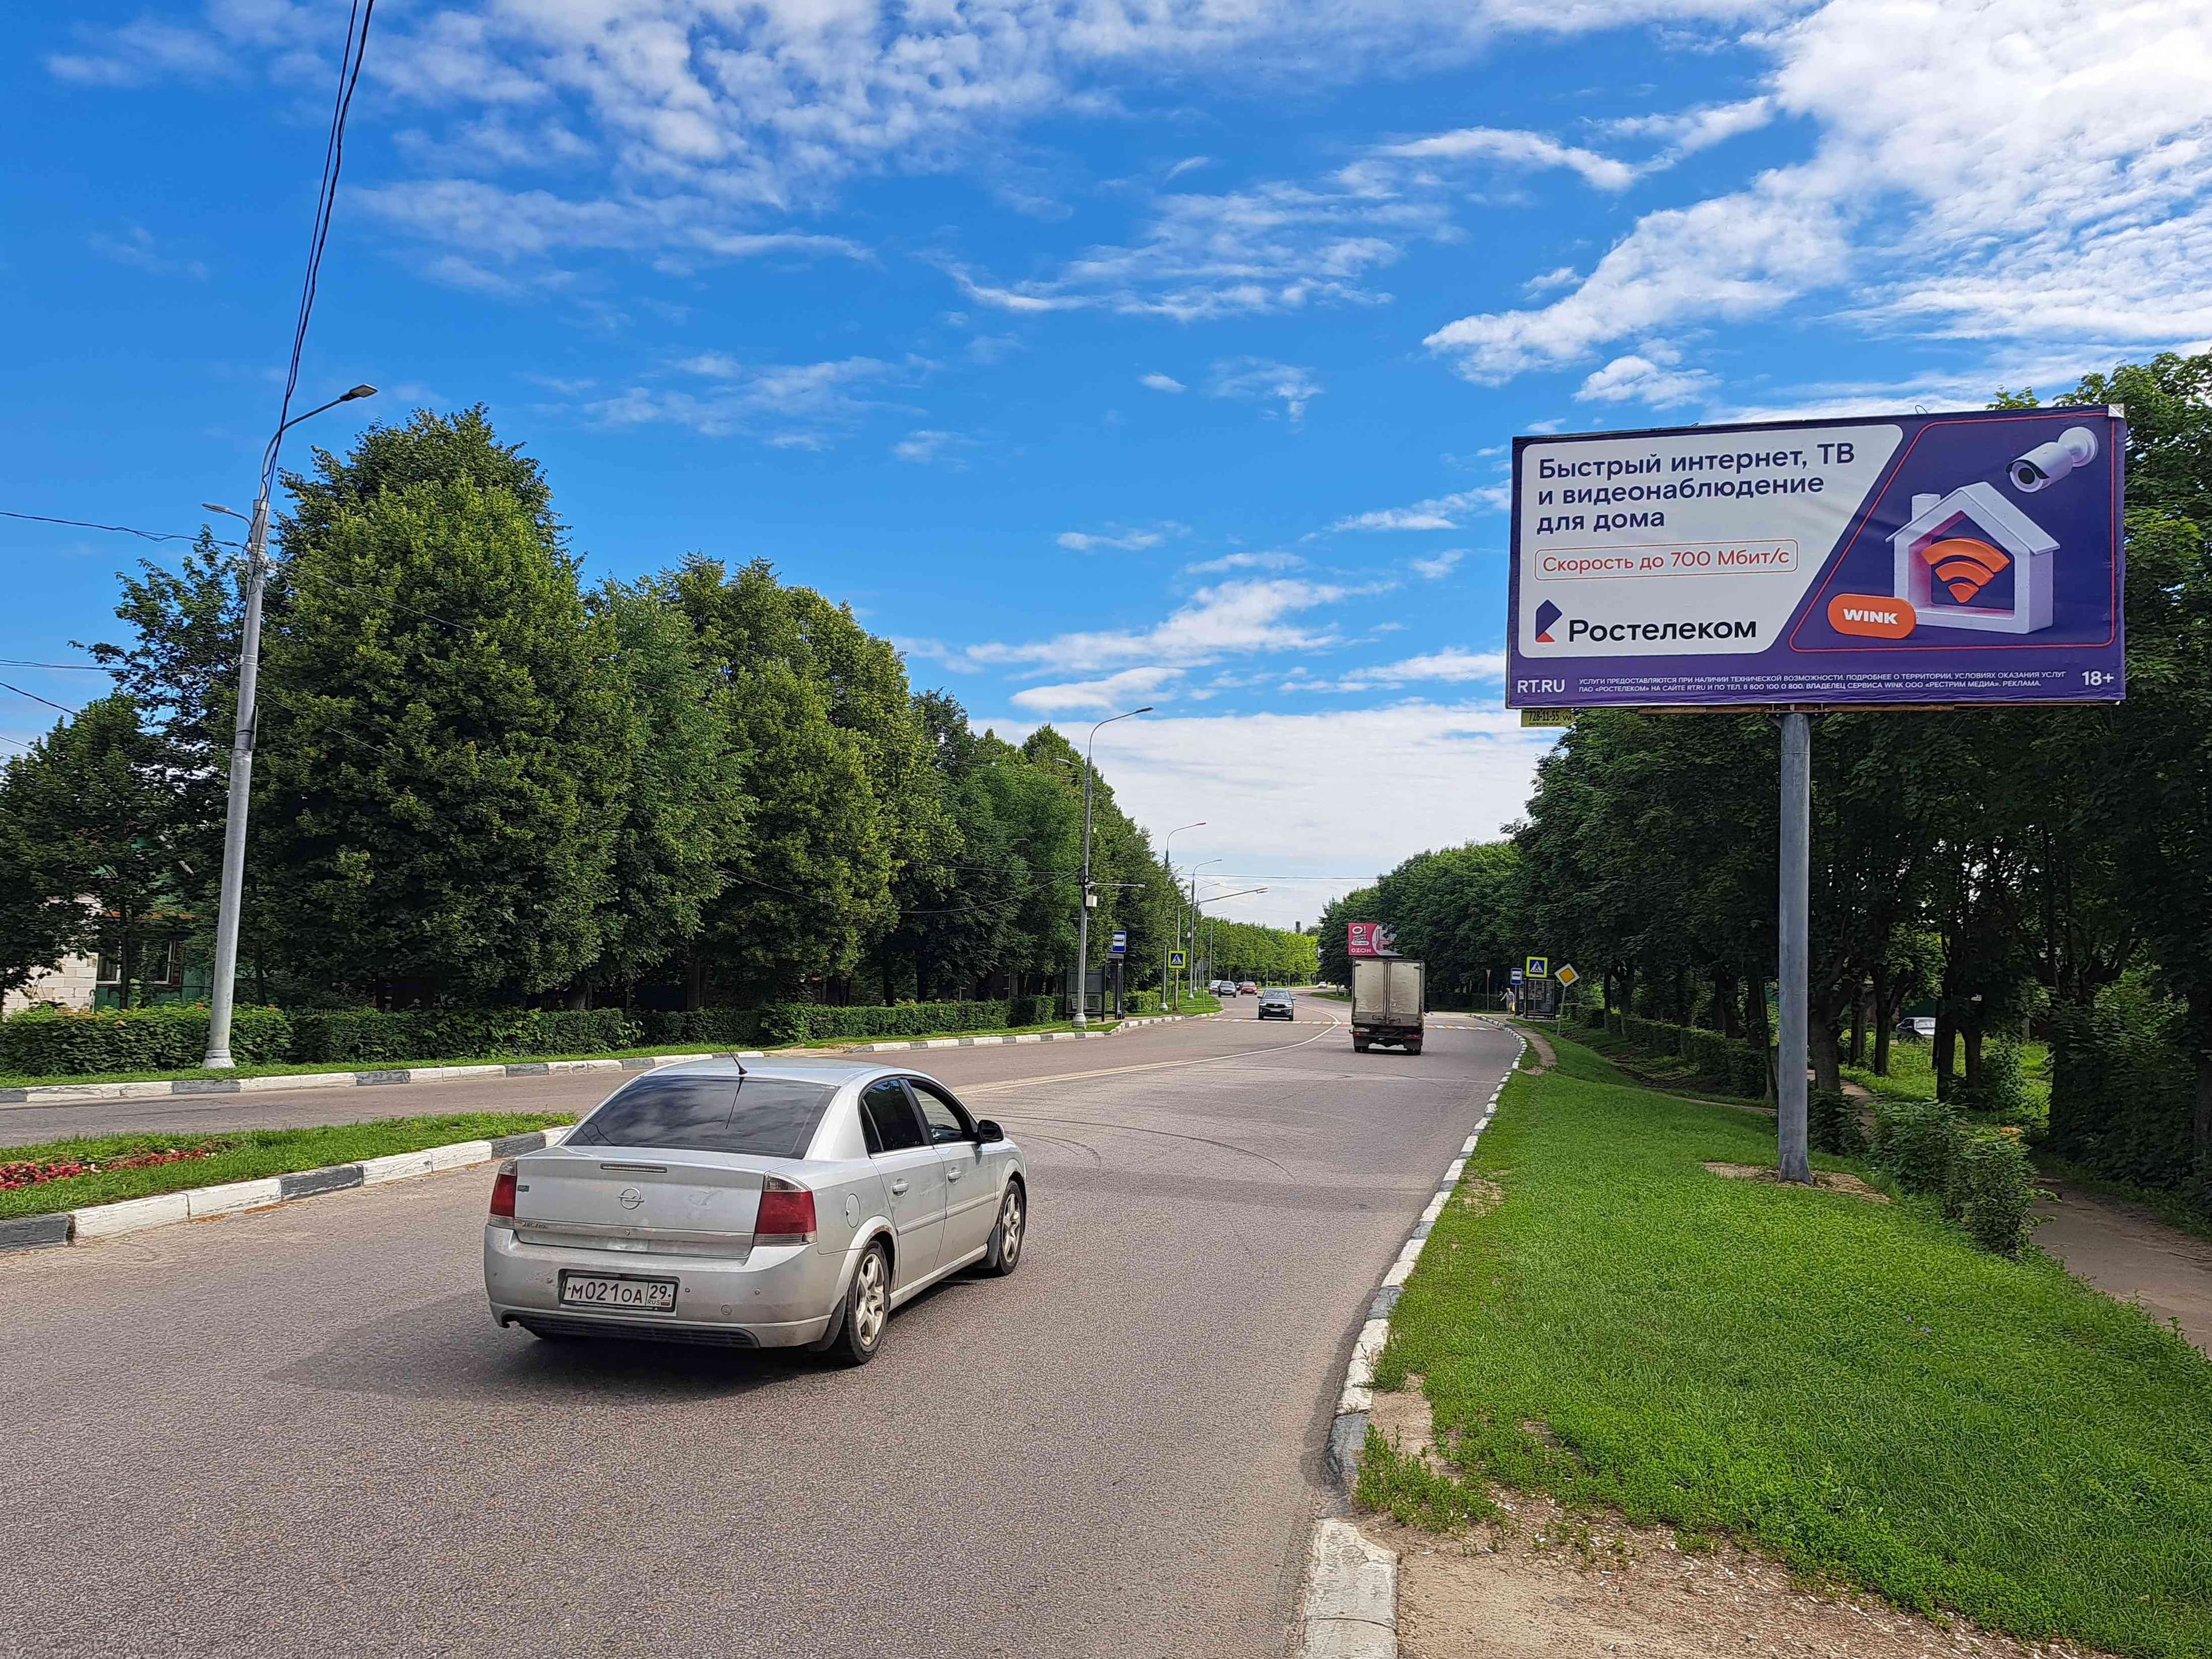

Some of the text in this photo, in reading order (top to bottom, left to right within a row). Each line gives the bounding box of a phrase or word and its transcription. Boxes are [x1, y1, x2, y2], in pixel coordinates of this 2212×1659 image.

[1539, 442, 1855, 480] Быстрый интернет, ТВ
[1539, 477, 1824, 506] и видеонаблюдение
[1537, 511, 1665, 535] для дома
[1543, 547, 1790, 574] Скорость до 700 Мбит/с
[1843, 608, 1899, 625] WINK
[1569, 619, 1758, 642] Ростелеком
[1517, 679, 1566, 694] RT.RU
[1730, 674, 1782, 682] ТЕХНИЧЕСКОЙ
[2081, 671, 2115, 686] 18+
[1529, 710, 1559, 721] 728-11-55
[570, 1281, 668, 1304] М021ОА 29
